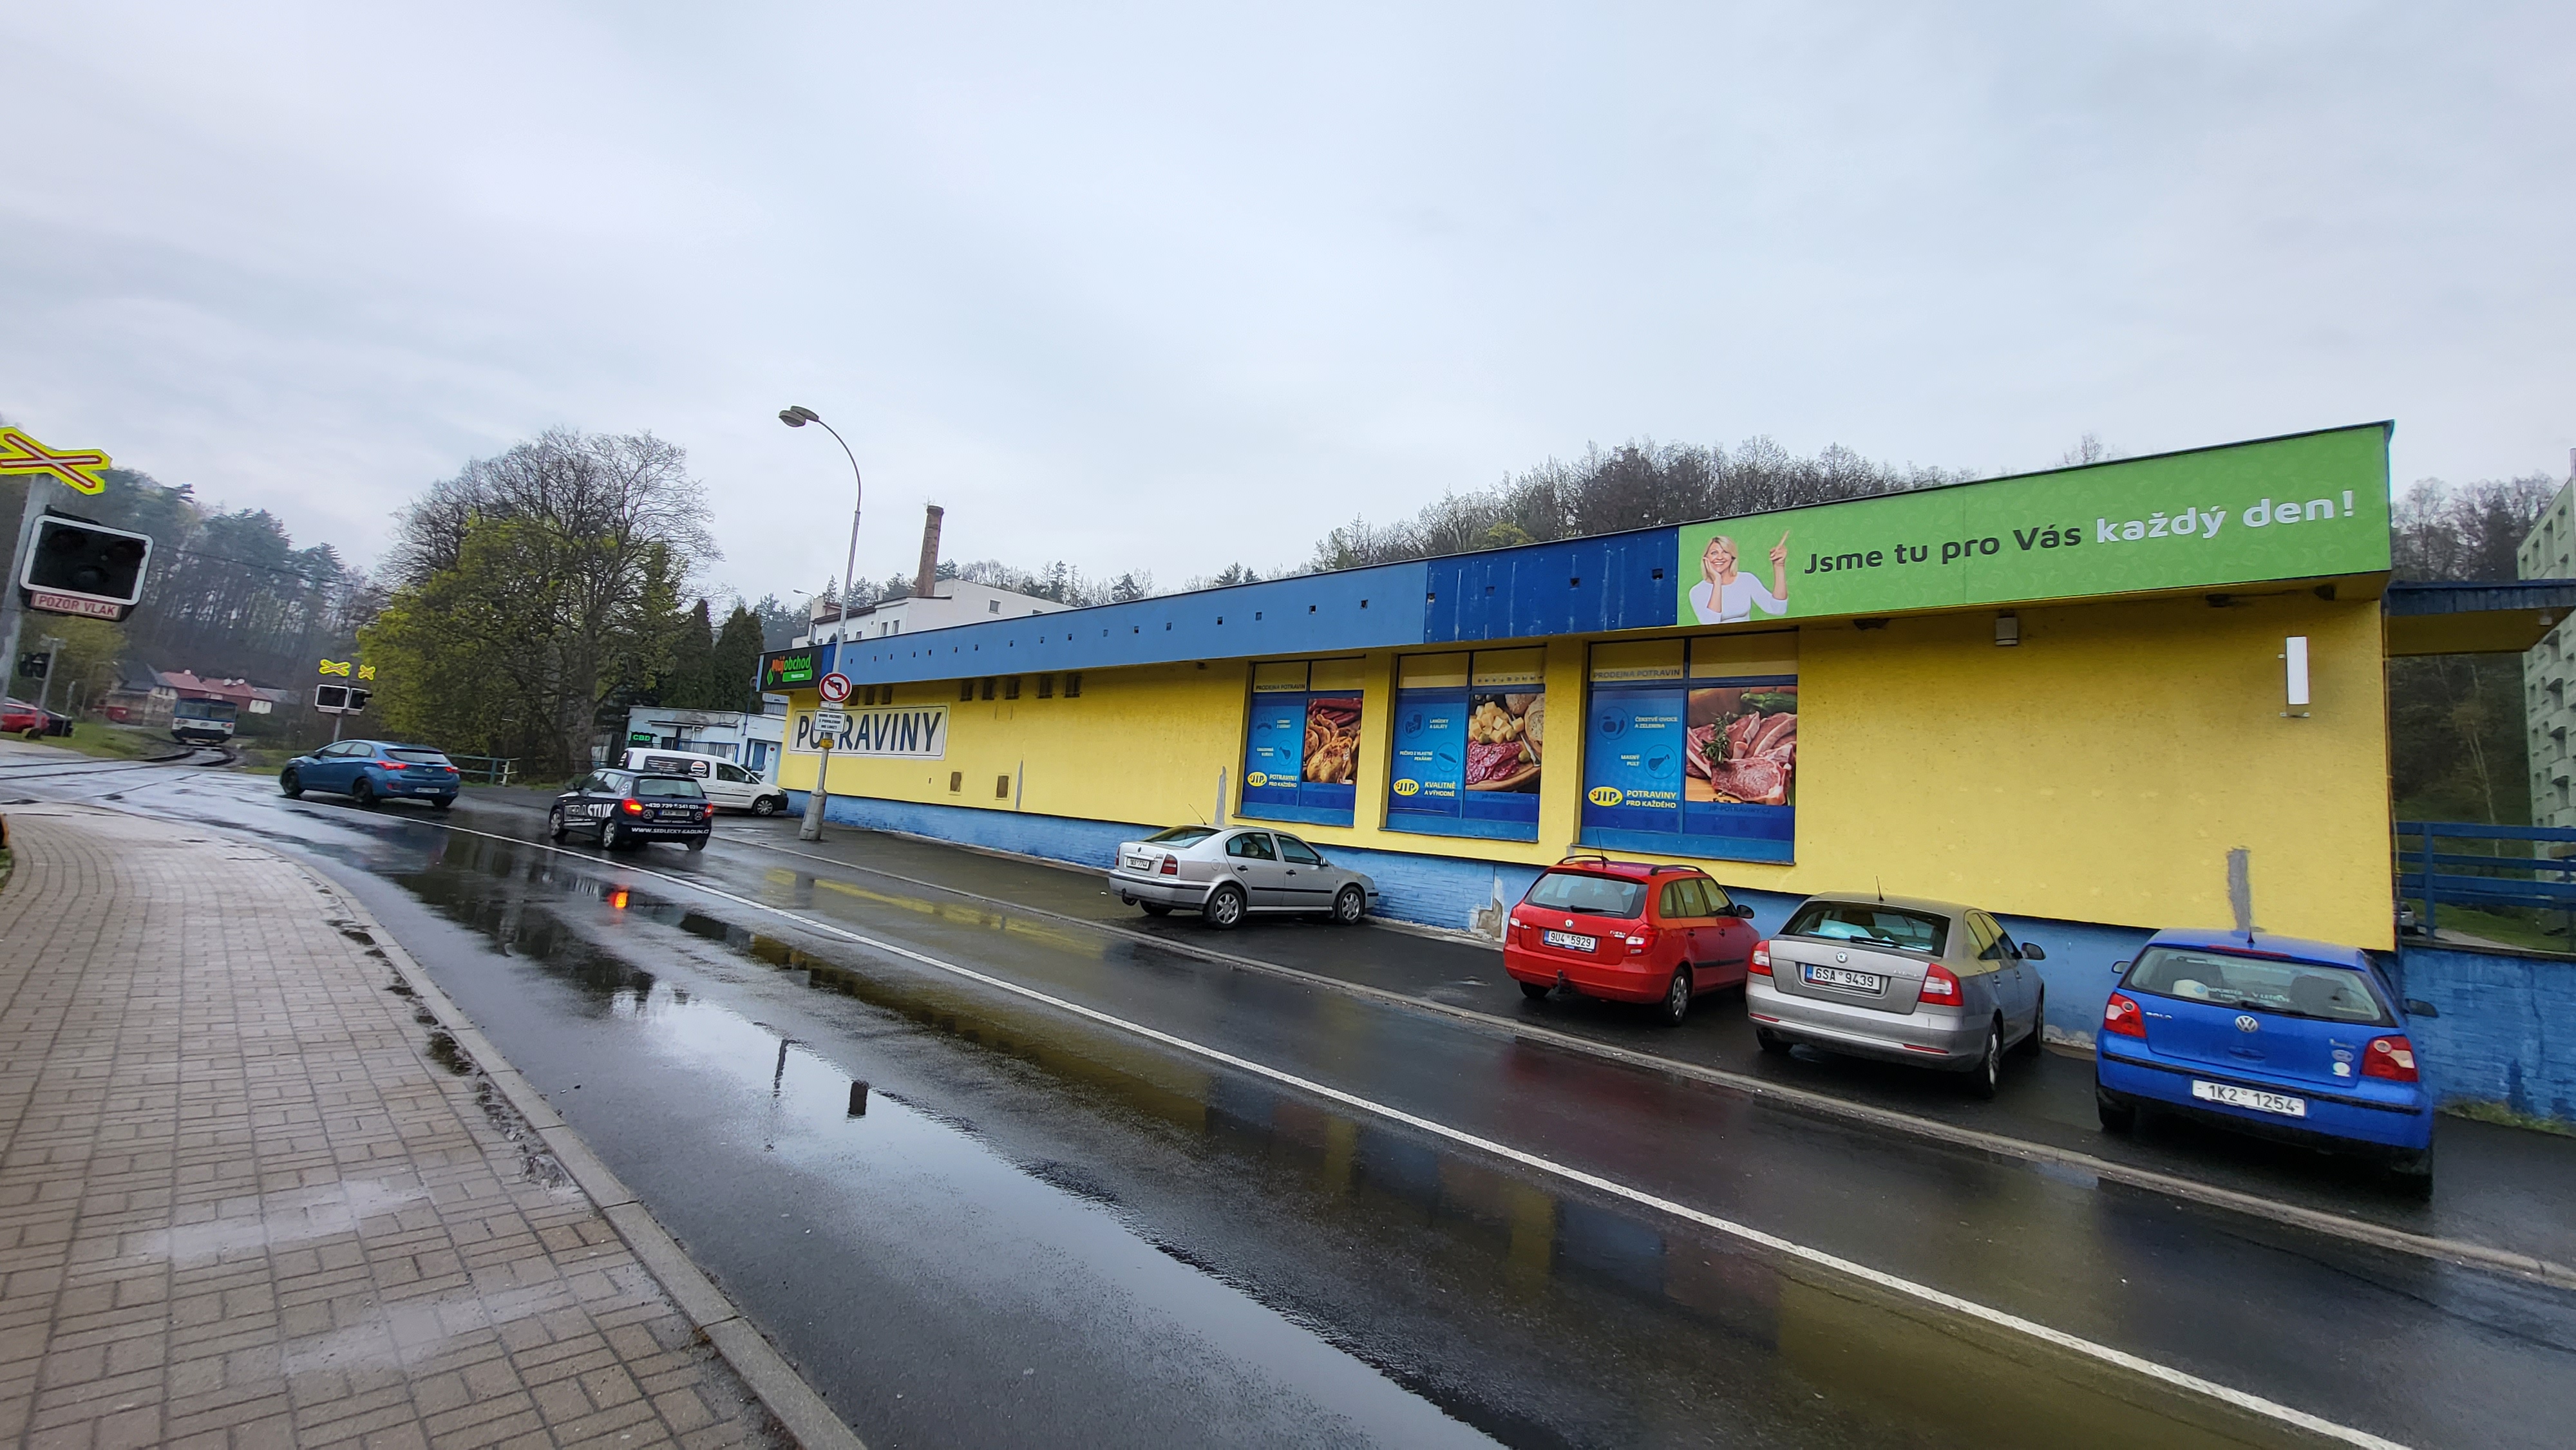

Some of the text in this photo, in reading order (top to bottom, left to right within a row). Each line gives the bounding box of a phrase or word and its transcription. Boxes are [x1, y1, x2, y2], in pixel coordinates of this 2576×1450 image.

[1804, 490, 2354, 574] Jsme tu pro Vás každý den!
[39, 596, 116, 616] POZOR VLAK
[1593, 670, 1636, 679] PRODEJNA
[796, 711, 942, 752] PORAVINY
[1251, 775, 1264, 784] JIP
[1397, 782, 1415, 792] JIP
[1594, 790, 1617, 802] JIP
[1626, 789, 1677, 800] POTRAVINY
[1642, 799, 1676, 809] KAŽDÉHO
[1550, 932, 1591, 947] 9U4 5929
[1815, 968, 1873, 987] 6SA 9439
[2208, 1085, 2296, 1113] 1K2 1254
